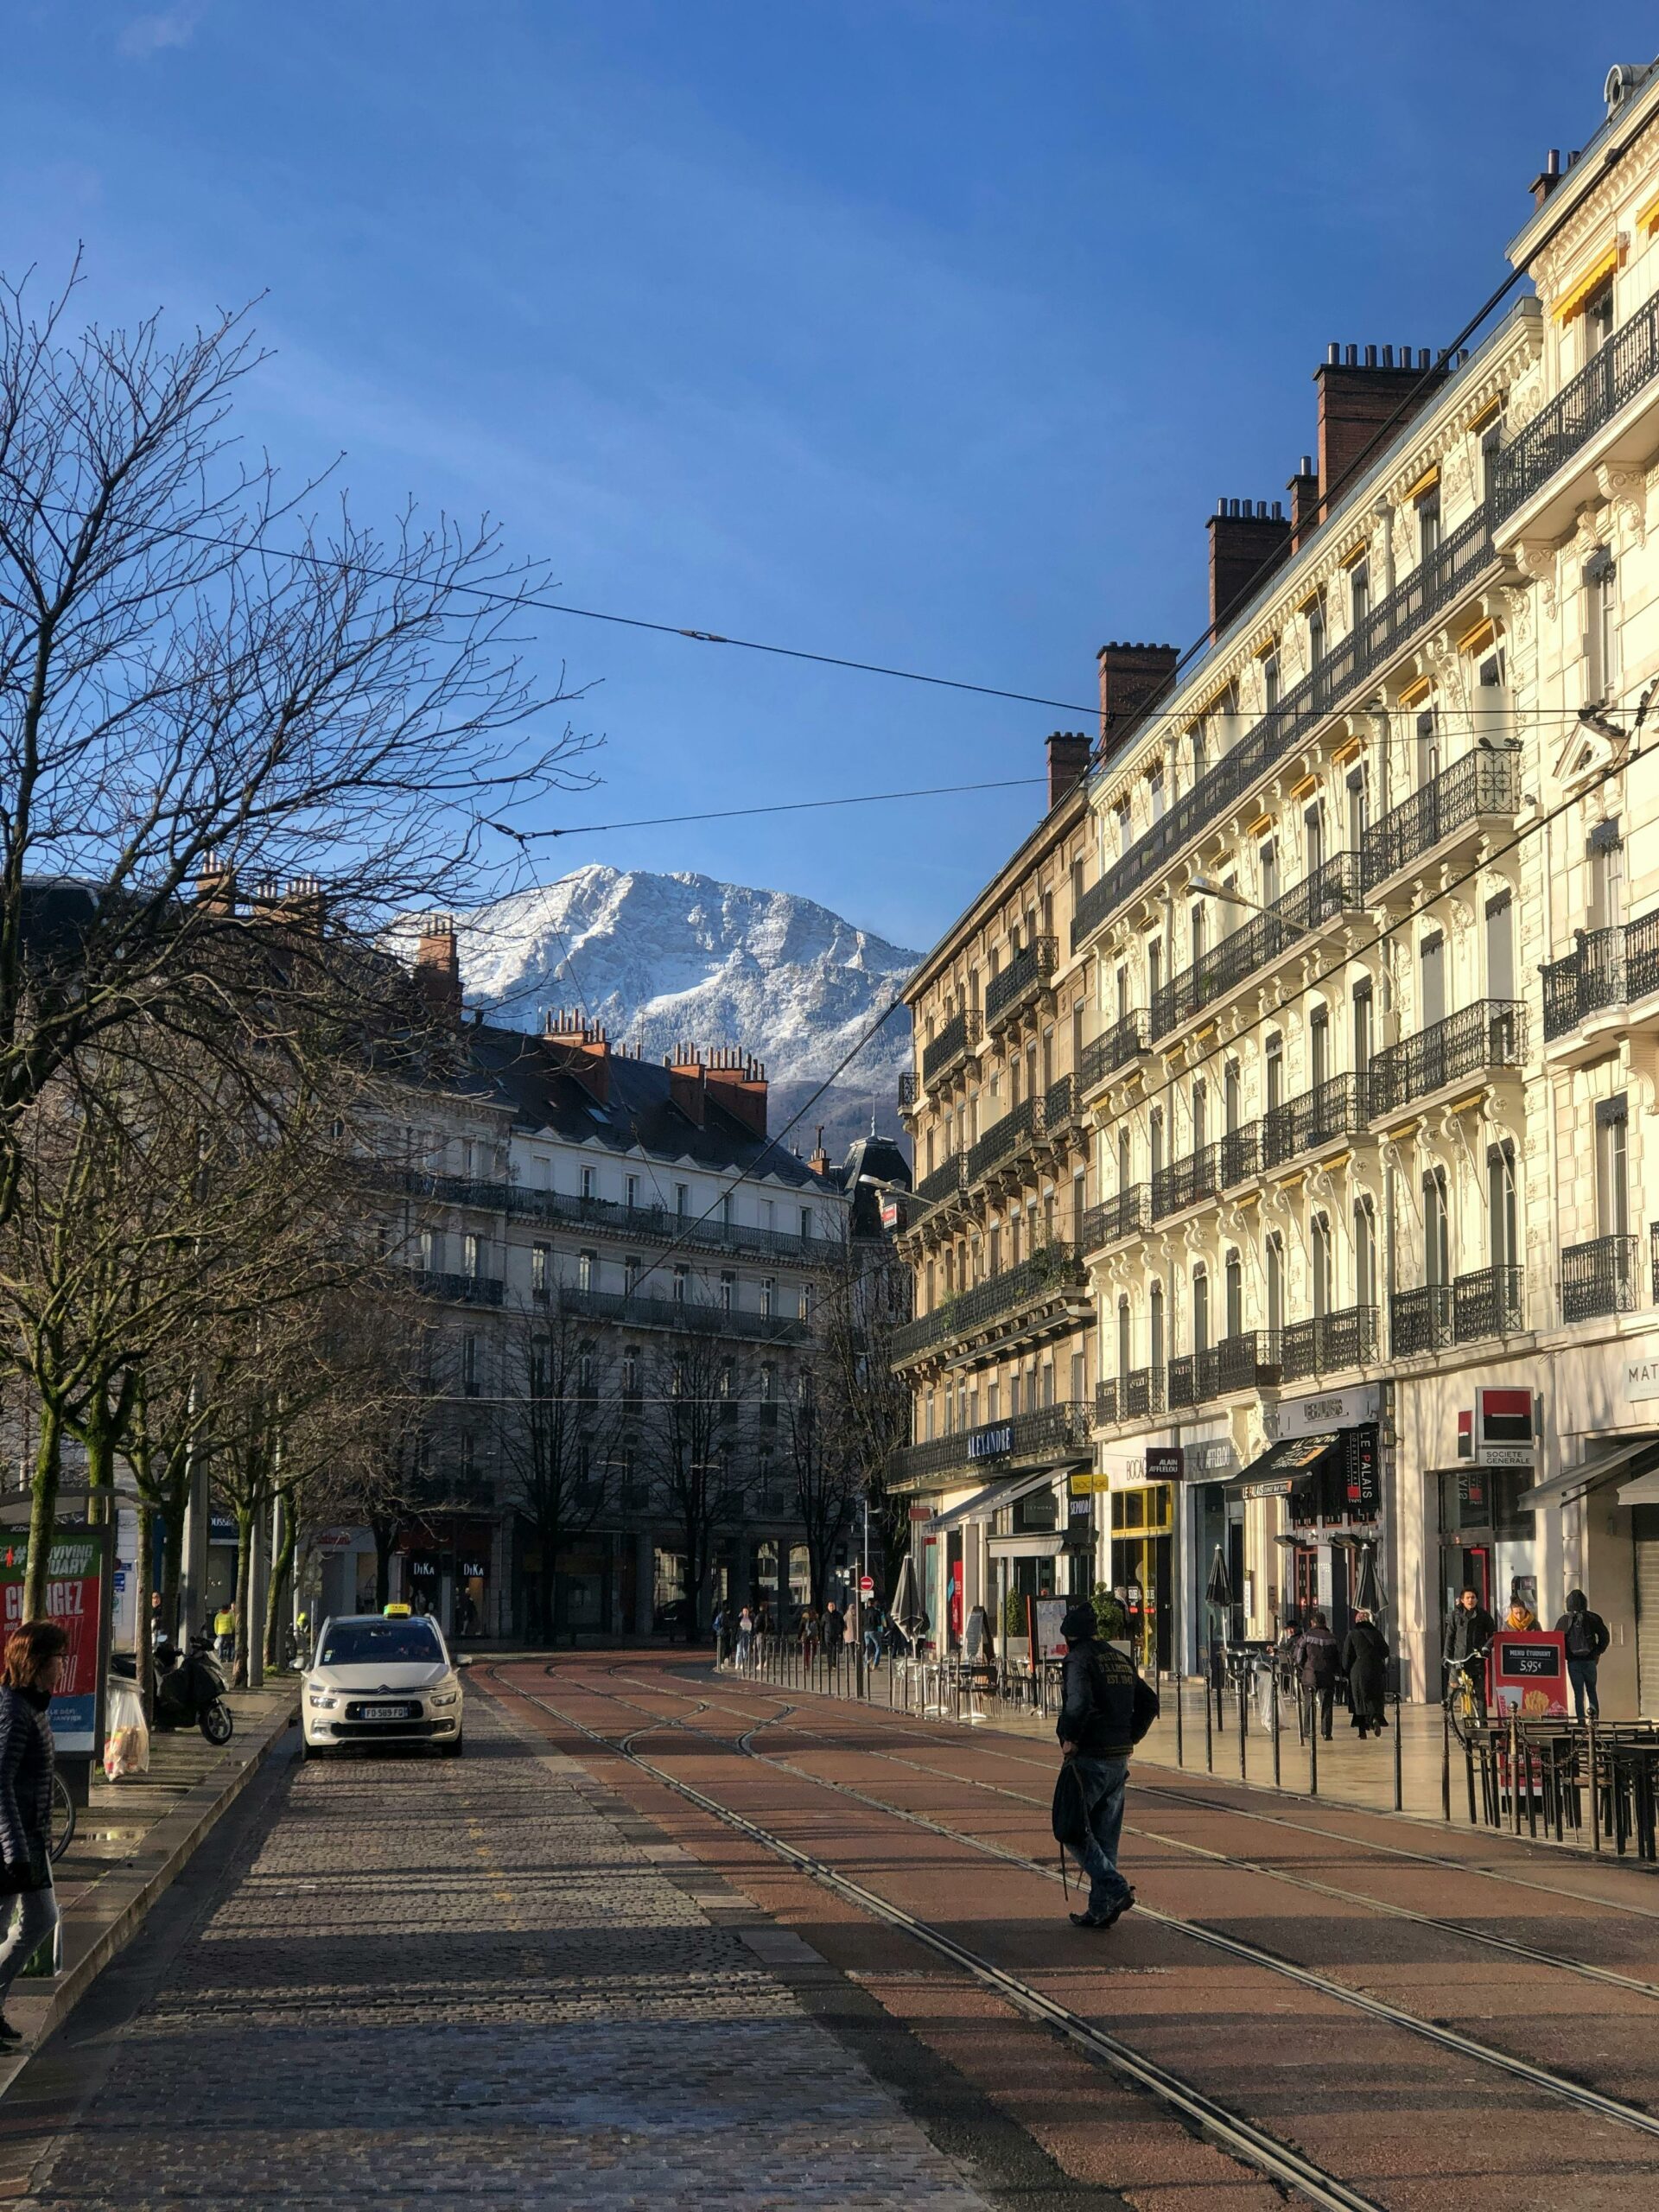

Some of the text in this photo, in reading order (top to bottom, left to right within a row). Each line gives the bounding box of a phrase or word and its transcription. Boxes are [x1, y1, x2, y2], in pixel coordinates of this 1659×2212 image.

[967, 1427, 1011, 1459] ALEXANDRE
[1361, 1433, 1372, 1498] LE PALAIS
